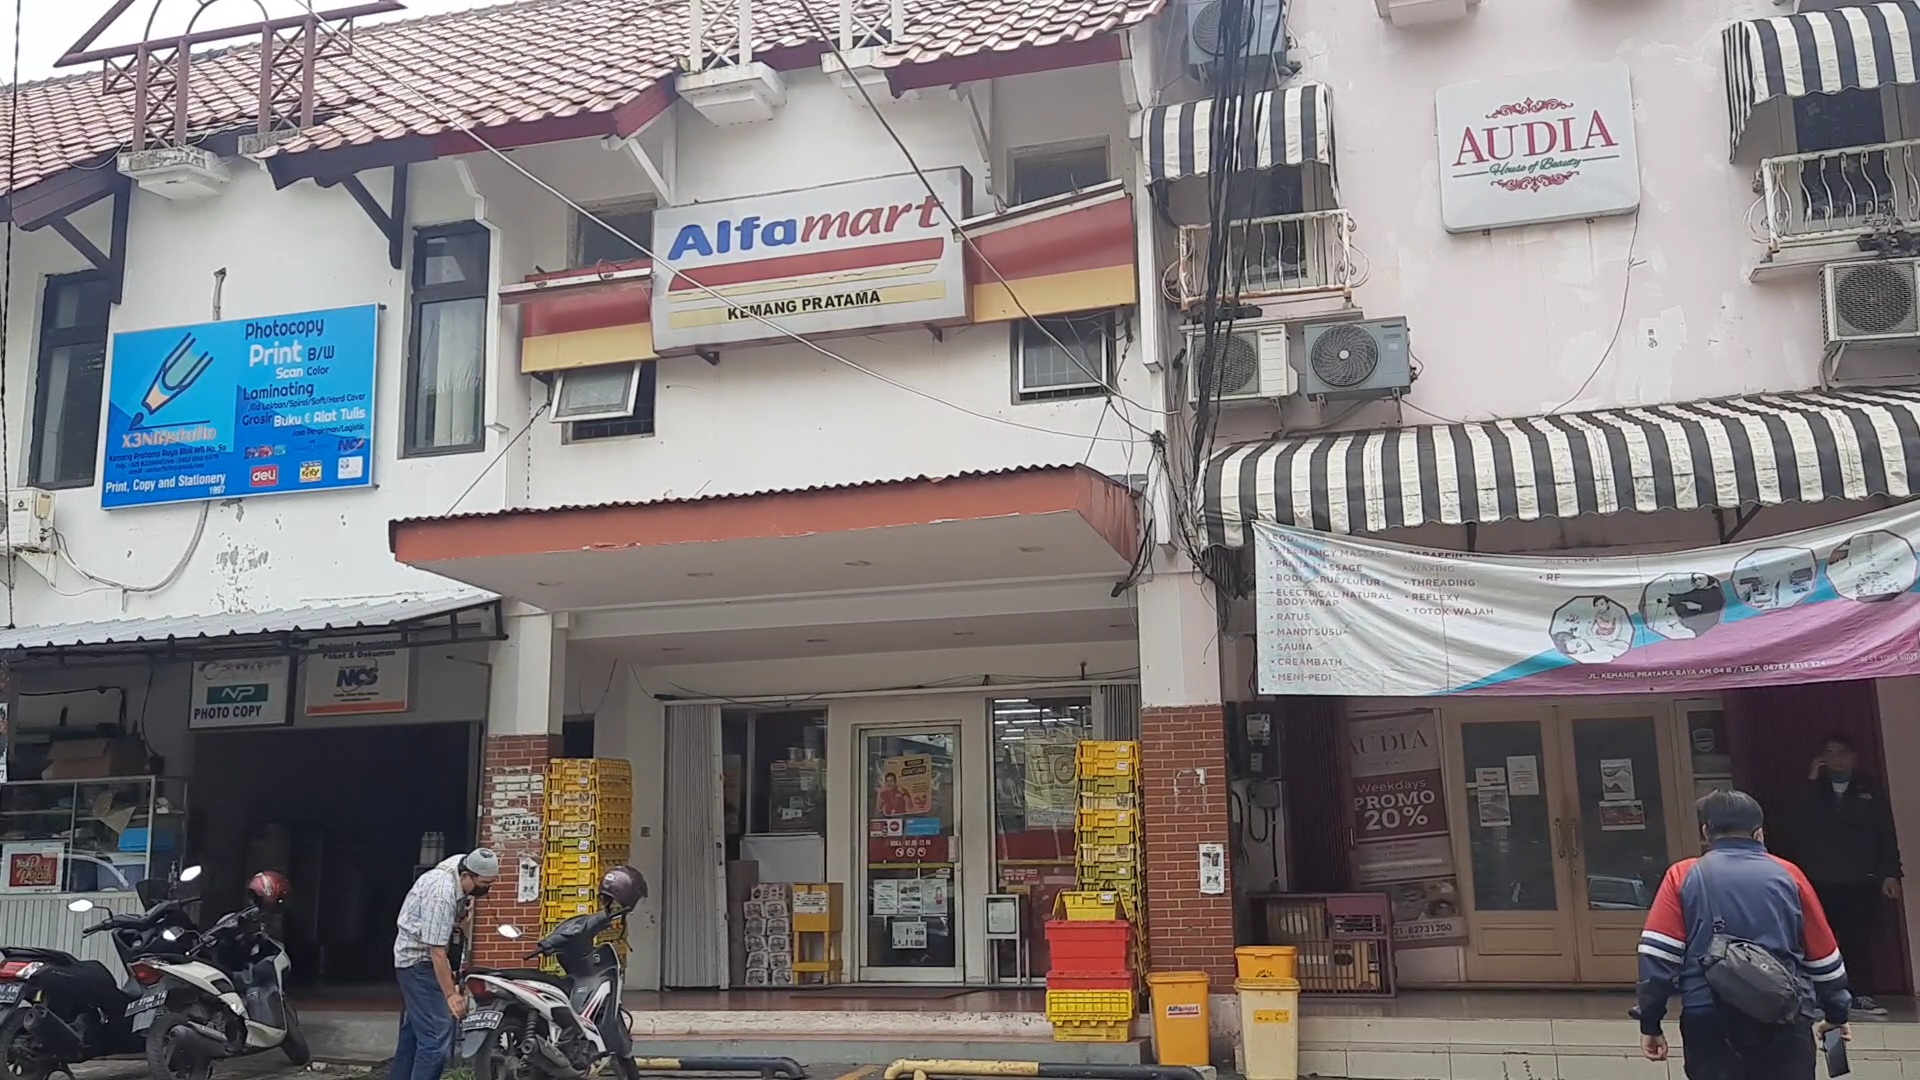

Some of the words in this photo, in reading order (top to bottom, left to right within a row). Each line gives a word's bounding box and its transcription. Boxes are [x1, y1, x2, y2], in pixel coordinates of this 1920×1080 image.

[1452, 110, 1619, 166] AUDIA
[1489, 161, 1526, 175] House
[1528, 161, 1540, 173] of
[1540, 157, 1580, 169] Beauty
[668, 194, 945, 261] Alfamart
[728, 300, 797, 320] KEMANG
[801, 290, 881, 311] PRATAMA
[245, 319, 324, 340] Photocopy
[249, 339, 302, 367] Print
[307, 345, 335, 361] B/W
[276, 367, 303, 379] Scan
[307, 366, 329, 376] Color
[243, 381, 314, 400] Laminating
[242, 412, 272, 426] Grosir
[273, 414, 302, 427] Buku
[313, 409, 337, 423] Alat
[340, 406, 366, 420] Tulis
[105, 481, 130, 493] Print,
[133, 479, 155, 492] Copy
[158, 476, 176, 488] and
[178, 473, 226, 487] Stationery
[1341, 549, 1391, 558] MASSAGE
[1410, 565, 1455, 573] WAXING
[1410, 578, 1476, 587] THREADING
[1546, 573, 1561, 581] RF
[1277, 588, 1339, 598] ELECTRICAL
[1342, 590, 1392, 600] NATURAL
[1411, 593, 1460, 601] REFLEXY
[1277, 598, 1305, 606] BODY
[1309, 599, 1339, 607] WRAP
[1276, 613, 1311, 621] RATUS
[1413, 607, 1449, 615] TOTOK
[1453, 608, 1494, 616] WAJAH
[1276, 628, 1312, 636] MANDI
[1314, 628, 1342, 636] SUSU
[1277, 643, 1313, 651] SAUNA
[1277, 658, 1343, 666] CREAMBATH
[336, 667, 379, 688] NCS
[1278, 673, 1332, 681] MENI-PEDI
[1601, 671, 1635, 679] KEMANG
[1637, 670, 1674, 678] PRATAMA
[194, 706, 230, 719] PHOTO
[233, 704, 262, 717] COPY
[1357, 780, 1426, 794] Weekdays
[1354, 789, 1435, 811] PROMO
[1364, 805, 1429, 831] 20%
